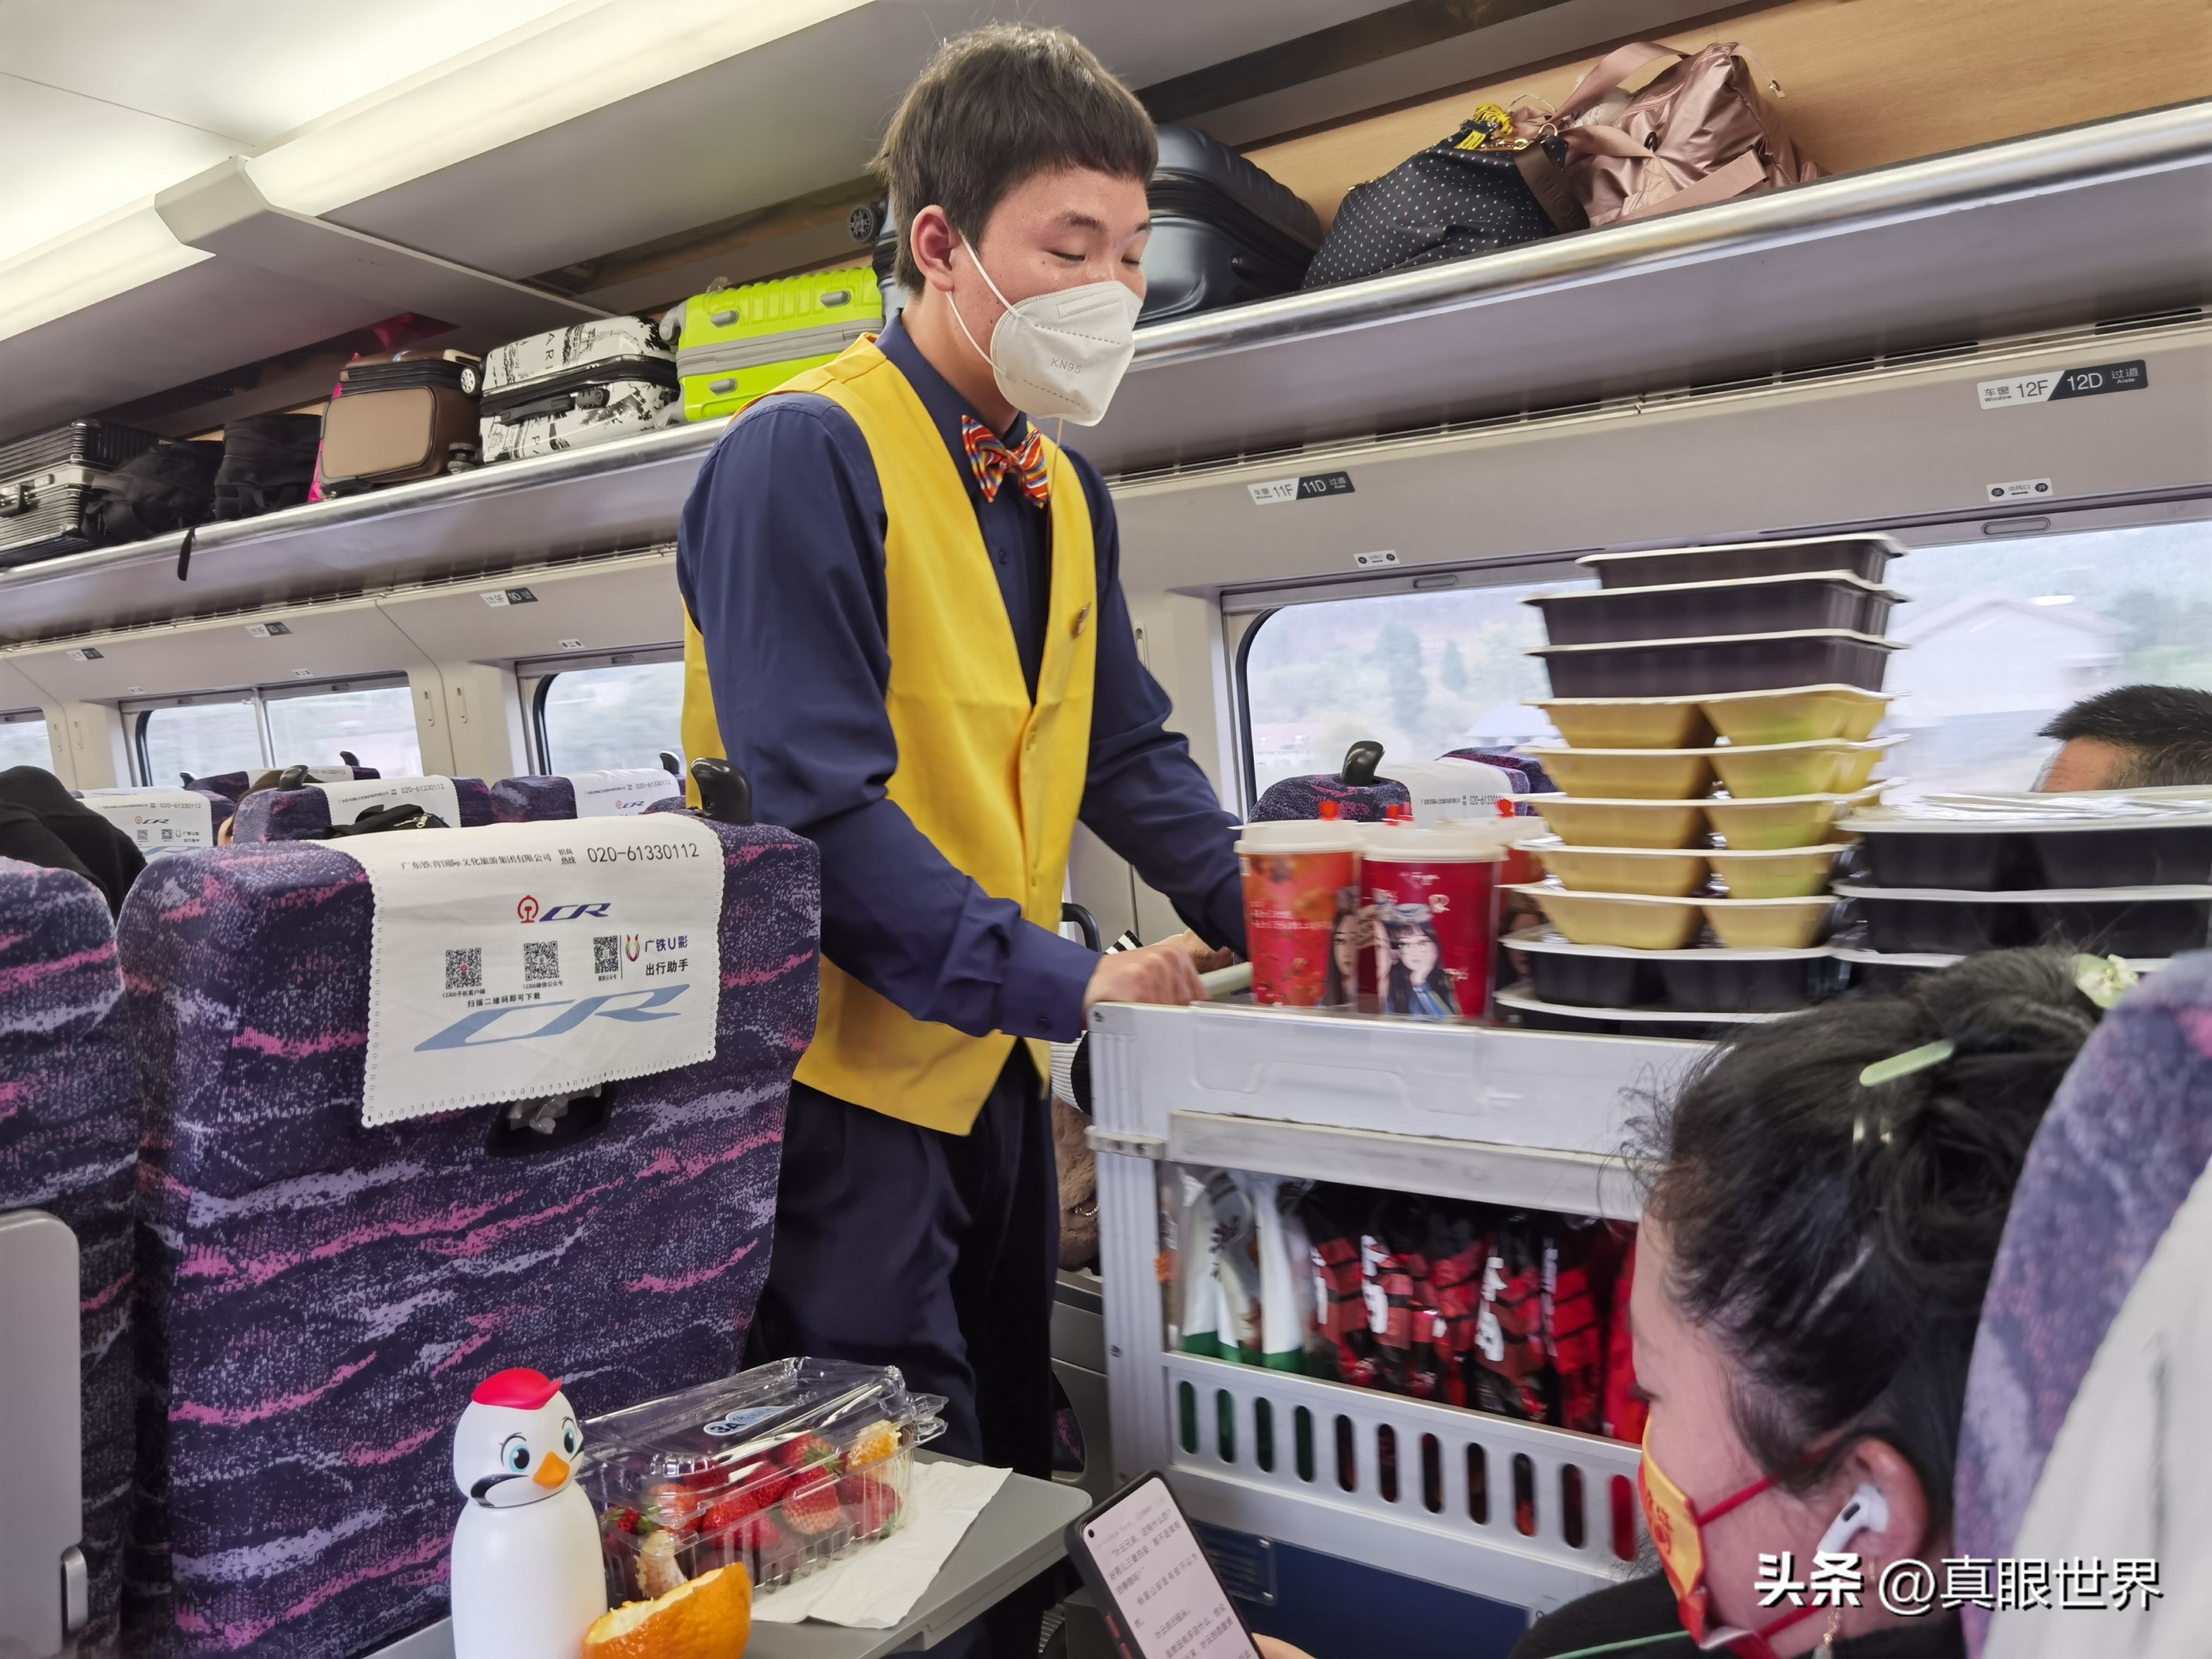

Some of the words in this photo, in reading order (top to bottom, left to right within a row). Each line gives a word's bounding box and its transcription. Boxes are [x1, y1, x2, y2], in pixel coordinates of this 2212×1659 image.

[1051, 357, 1082, 374] KN95
[2111, 367, 2139, 379] 过道
[1984, 386, 2010, 397] 车窗
[2016, 380, 2048, 398] 12F
[2067, 372, 2103, 391] 12D
[1272, 484, 1293, 497] 11F
[1302, 480, 1327, 494] 11D
[508, 592, 522, 601] 9D
[401, 783, 444, 794] 020-61330112
[636, 779, 671, 789] 020-61330112
[587, 843, 700, 863] 020-61330112
[561, 856, 576, 865] 热线
[539, 902, 611, 922] CR
[644, 934, 688, 953] 广铁U彩
[645, 958, 689, 976] 出行助手
[522, 979, 563, 990] 12306微信公众号
[442, 988, 485, 998] 12306手机客户端
[467, 992, 542, 1009] 扫描二维码即可下载
